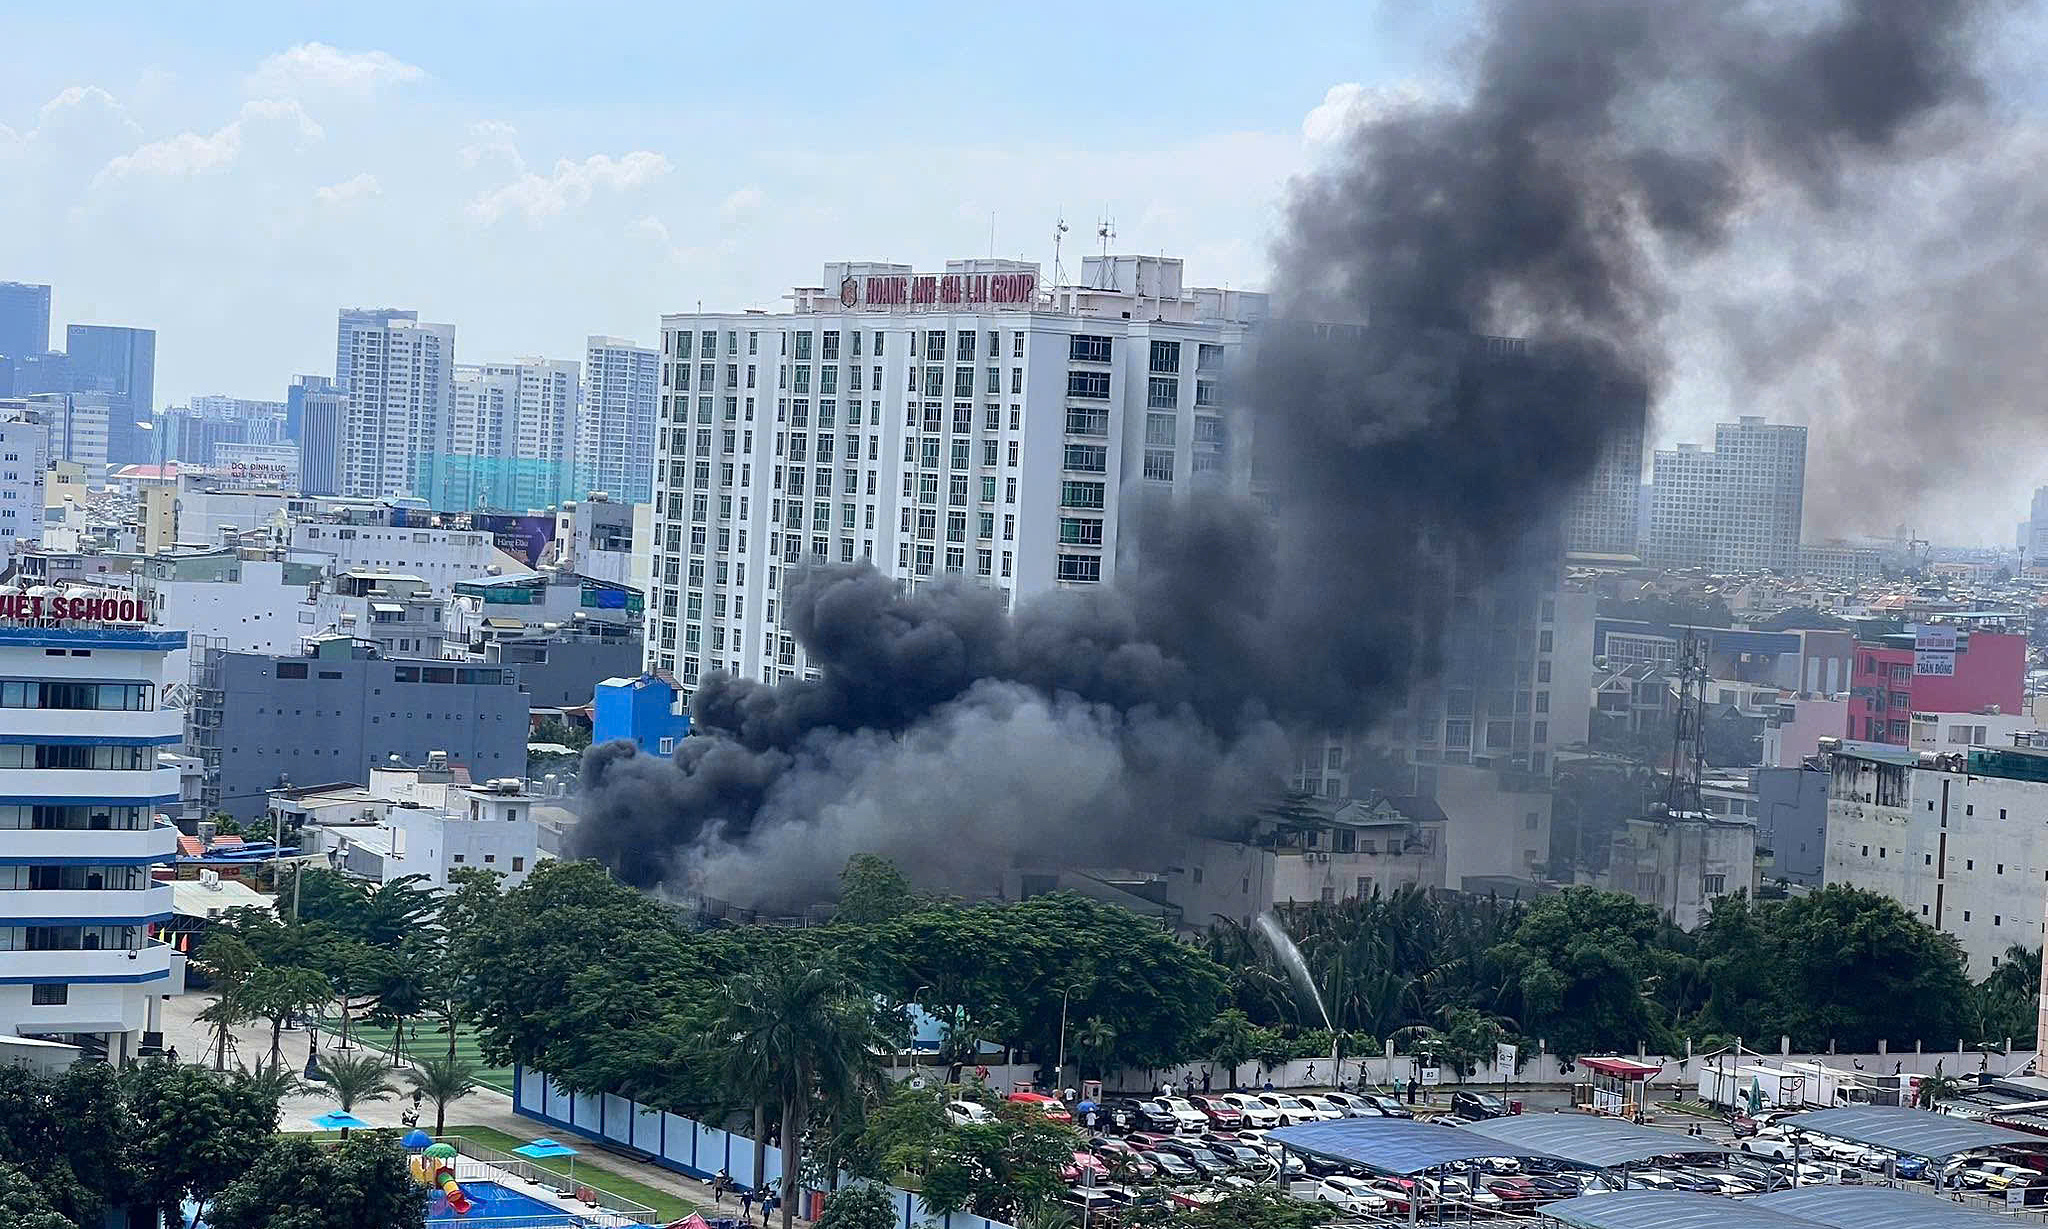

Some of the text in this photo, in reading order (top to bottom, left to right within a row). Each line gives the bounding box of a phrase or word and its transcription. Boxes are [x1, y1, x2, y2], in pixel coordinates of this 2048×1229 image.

[867, 274, 1035, 304] HOANG ANH GIA LAI GROUP
[52, 597, 149, 621] SCHOOL
